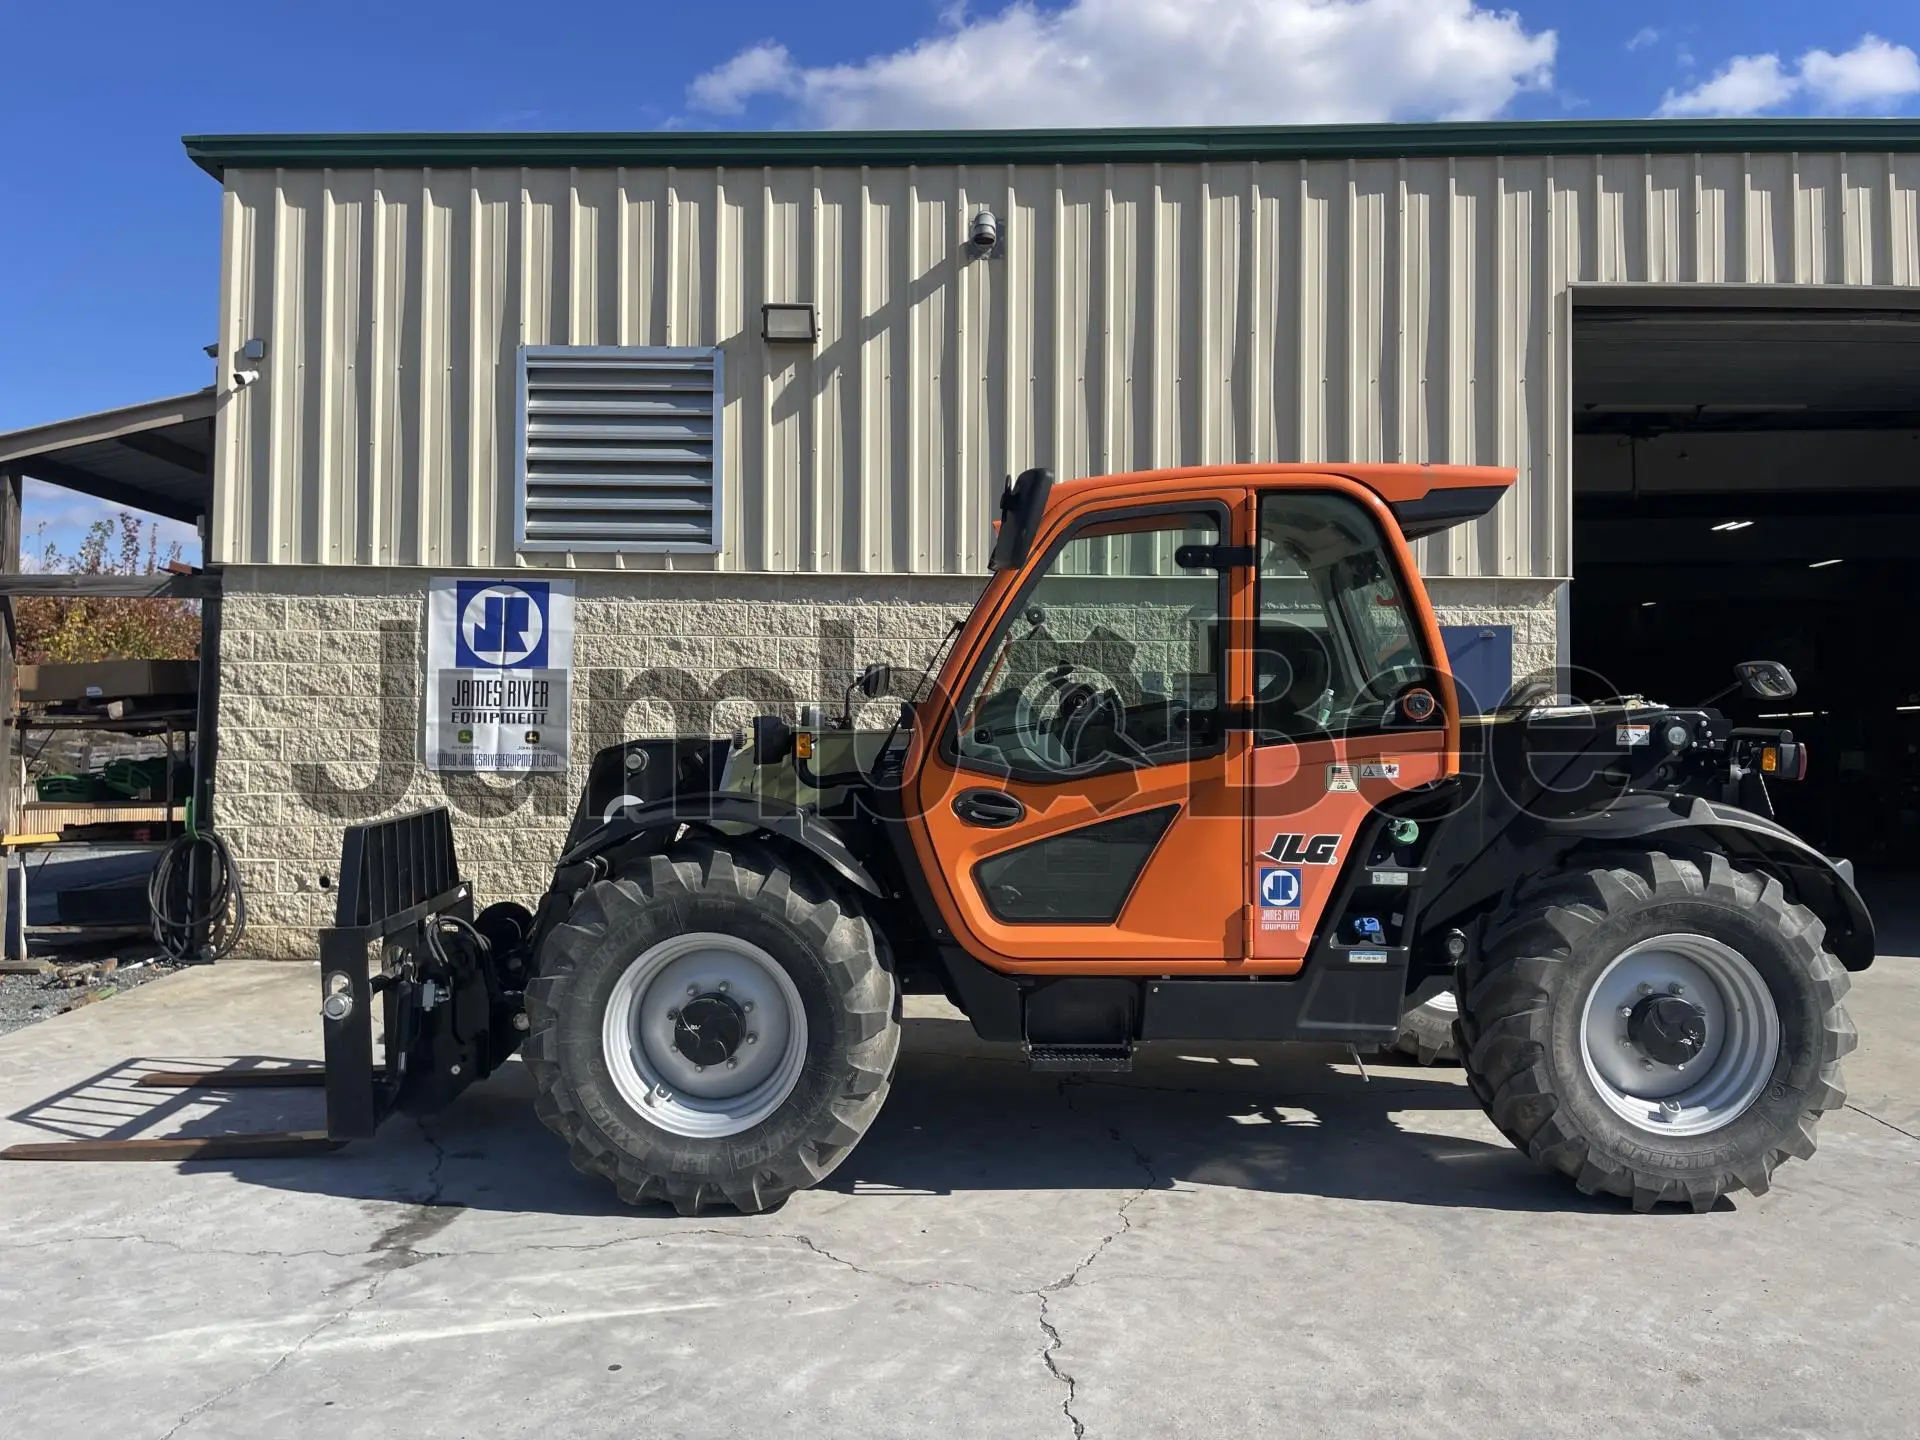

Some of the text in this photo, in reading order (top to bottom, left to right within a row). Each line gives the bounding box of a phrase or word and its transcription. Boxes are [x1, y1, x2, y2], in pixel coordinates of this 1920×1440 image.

[452, 679, 549, 708] JAMES RIVER
[451, 711, 548, 725] EQUIPMENT
[1262, 909, 1300, 921] JAMES RIVER
[1261, 923, 1299, 931] EQUIPMENT
